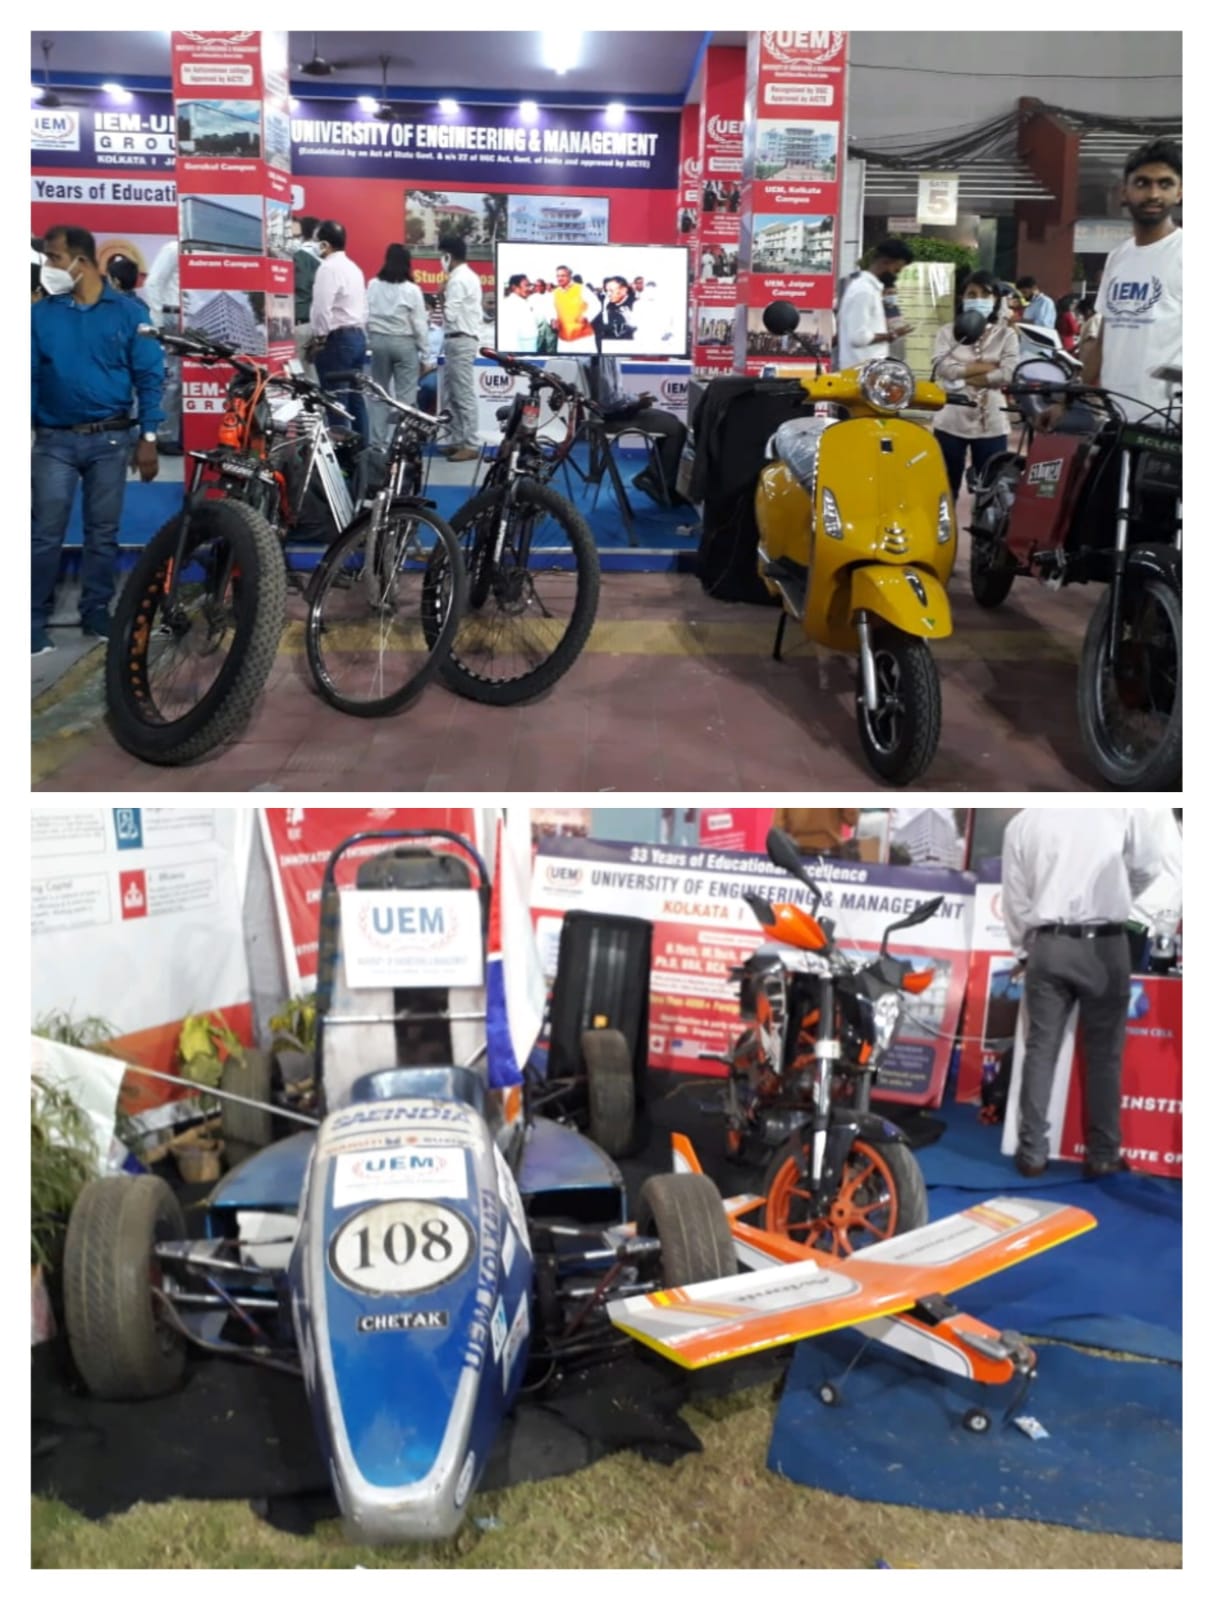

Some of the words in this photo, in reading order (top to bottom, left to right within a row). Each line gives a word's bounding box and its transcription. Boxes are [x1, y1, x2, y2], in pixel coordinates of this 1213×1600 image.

[775, 31, 830, 49] UEM
[35, 117, 66, 130] IEM
[291, 119, 390, 145] UNIVERSITY
[391, 122, 413, 147] OF
[415, 124, 527, 151] ENGINEERING
[528, 128, 542, 152] &
[543, 129, 659, 156] MANAGEMENT
[97, 154, 147, 165] KOLKATA
[221, 163, 257, 173] Campus
[34, 180, 83, 199] Years
[89, 183, 105, 200] of
[111, 184, 176, 202] Educati
[775, 195, 810, 204] Campus
[927, 189, 950, 215] 5
[223, 260, 260, 269] Campus
[772, 288, 807, 298] Campus
[1112, 282, 1149, 301] IEM
[182, 382, 230, 397] IEM-
[485, 374, 509, 387] UEM
[630, 847, 648, 864] 33
[650, 848, 687, 867] Years
[690, 851, 705, 868] of
[551, 867, 579, 880] UEM
[591, 869, 678, 893] UNIVERSITY
[684, 878, 704, 896] OF
[823, 892, 834, 908] &
[663, 899, 729, 920] KOLKATA
[372, 905, 446, 935] UEM
[365, 1155, 434, 1172] UEM
[353, 1218, 453, 1271] 108
[360, 1311, 442, 1331] CHETAK
